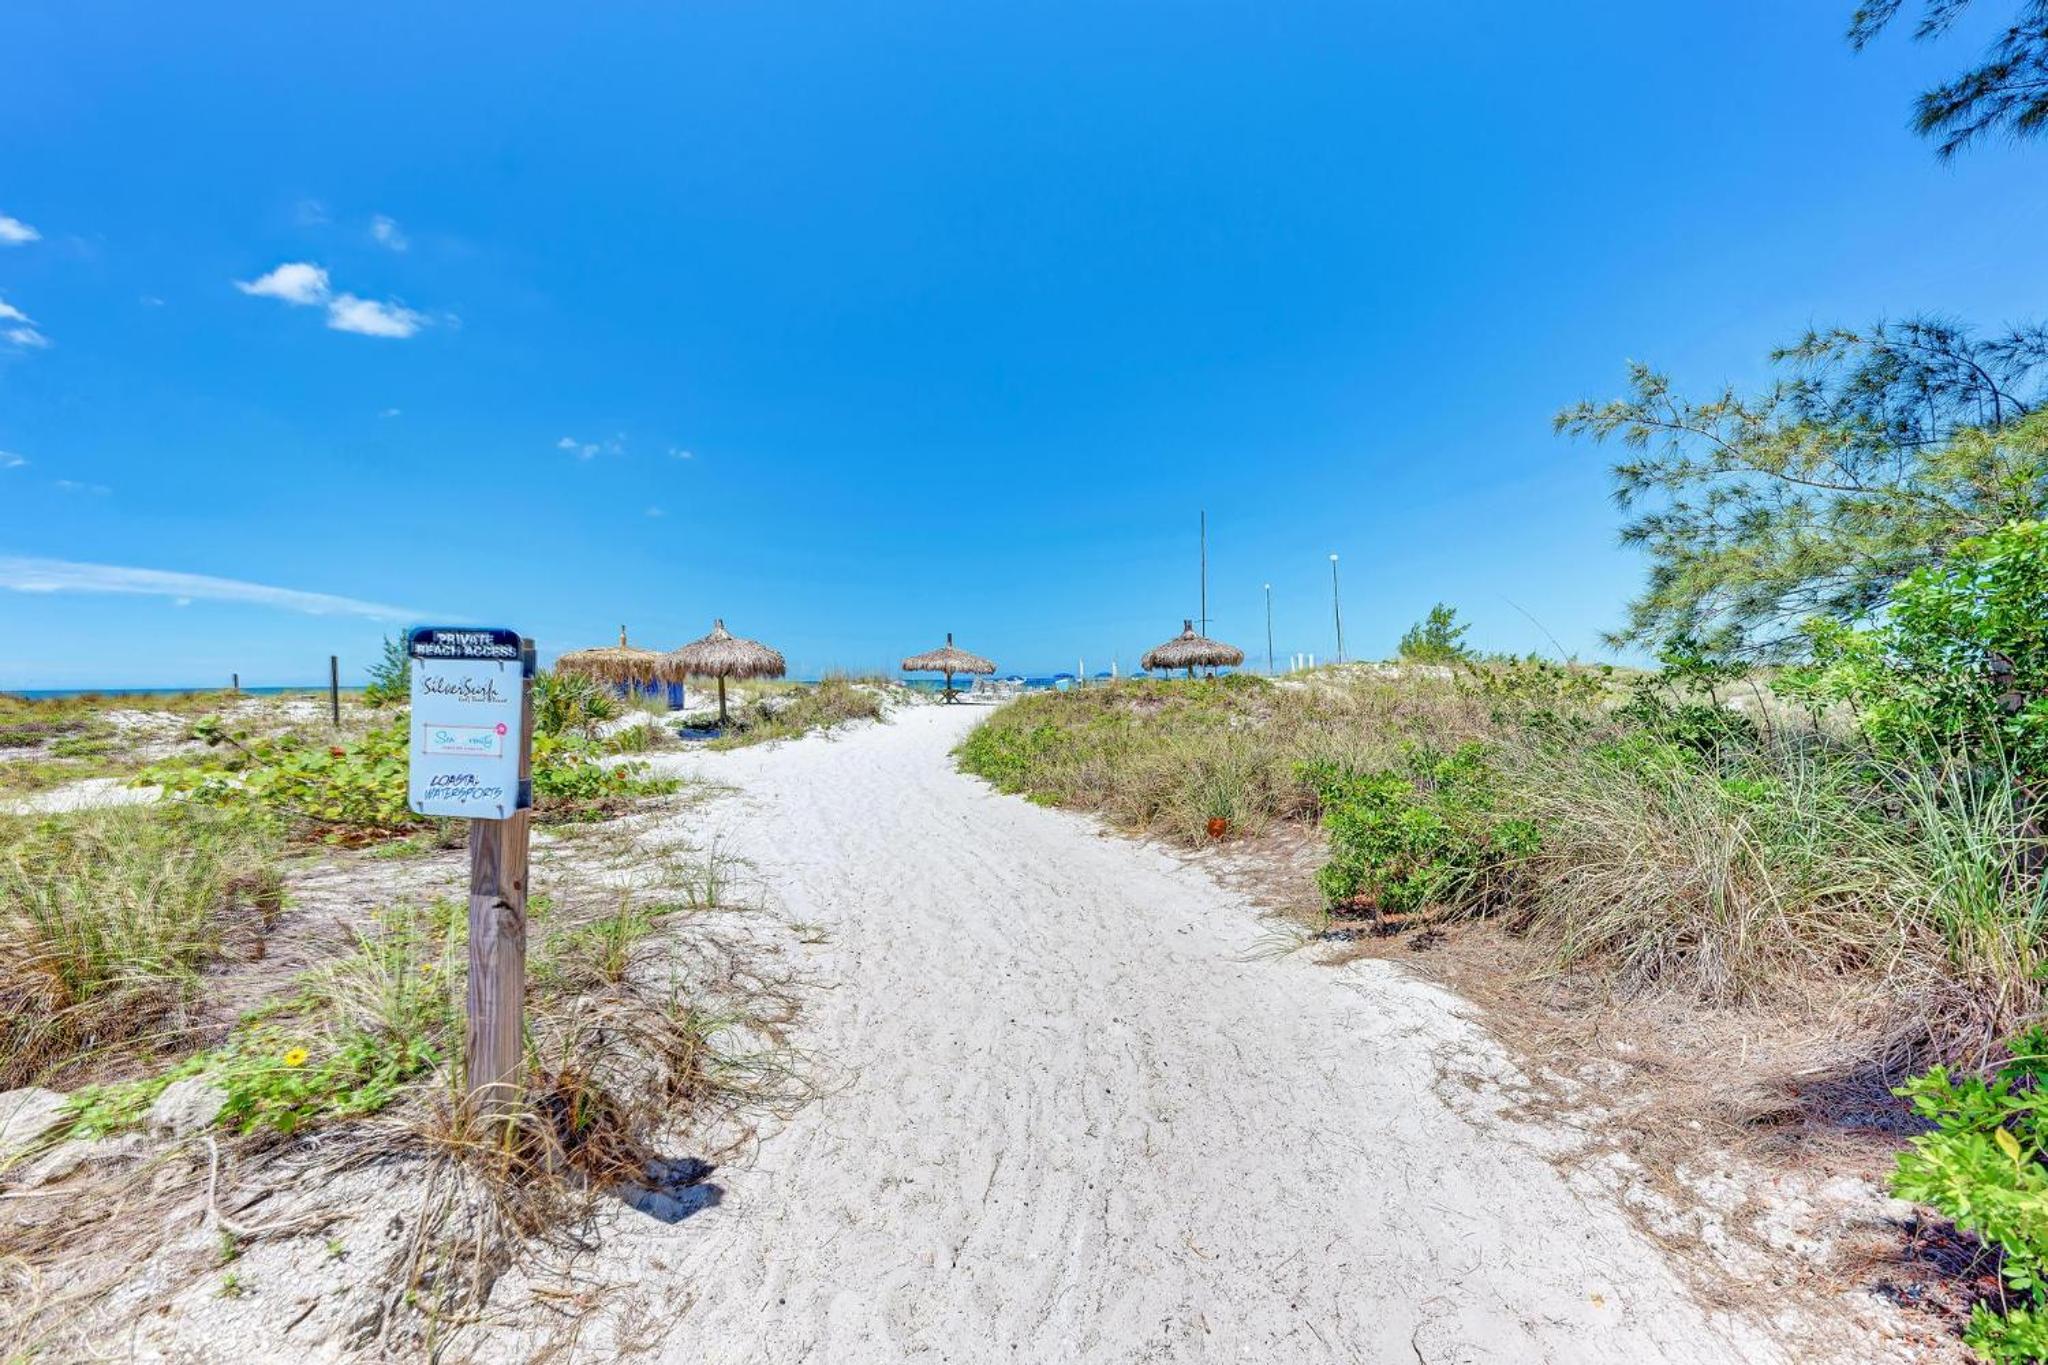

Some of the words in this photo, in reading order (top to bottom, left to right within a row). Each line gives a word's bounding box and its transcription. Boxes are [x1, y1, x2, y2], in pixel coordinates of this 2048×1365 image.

[436, 632, 494, 645] PRIVATE
[415, 643, 461, 657] BEACH
[464, 645, 517, 658] ACCESS
[424, 787, 503, 800] WATERSPORTS
